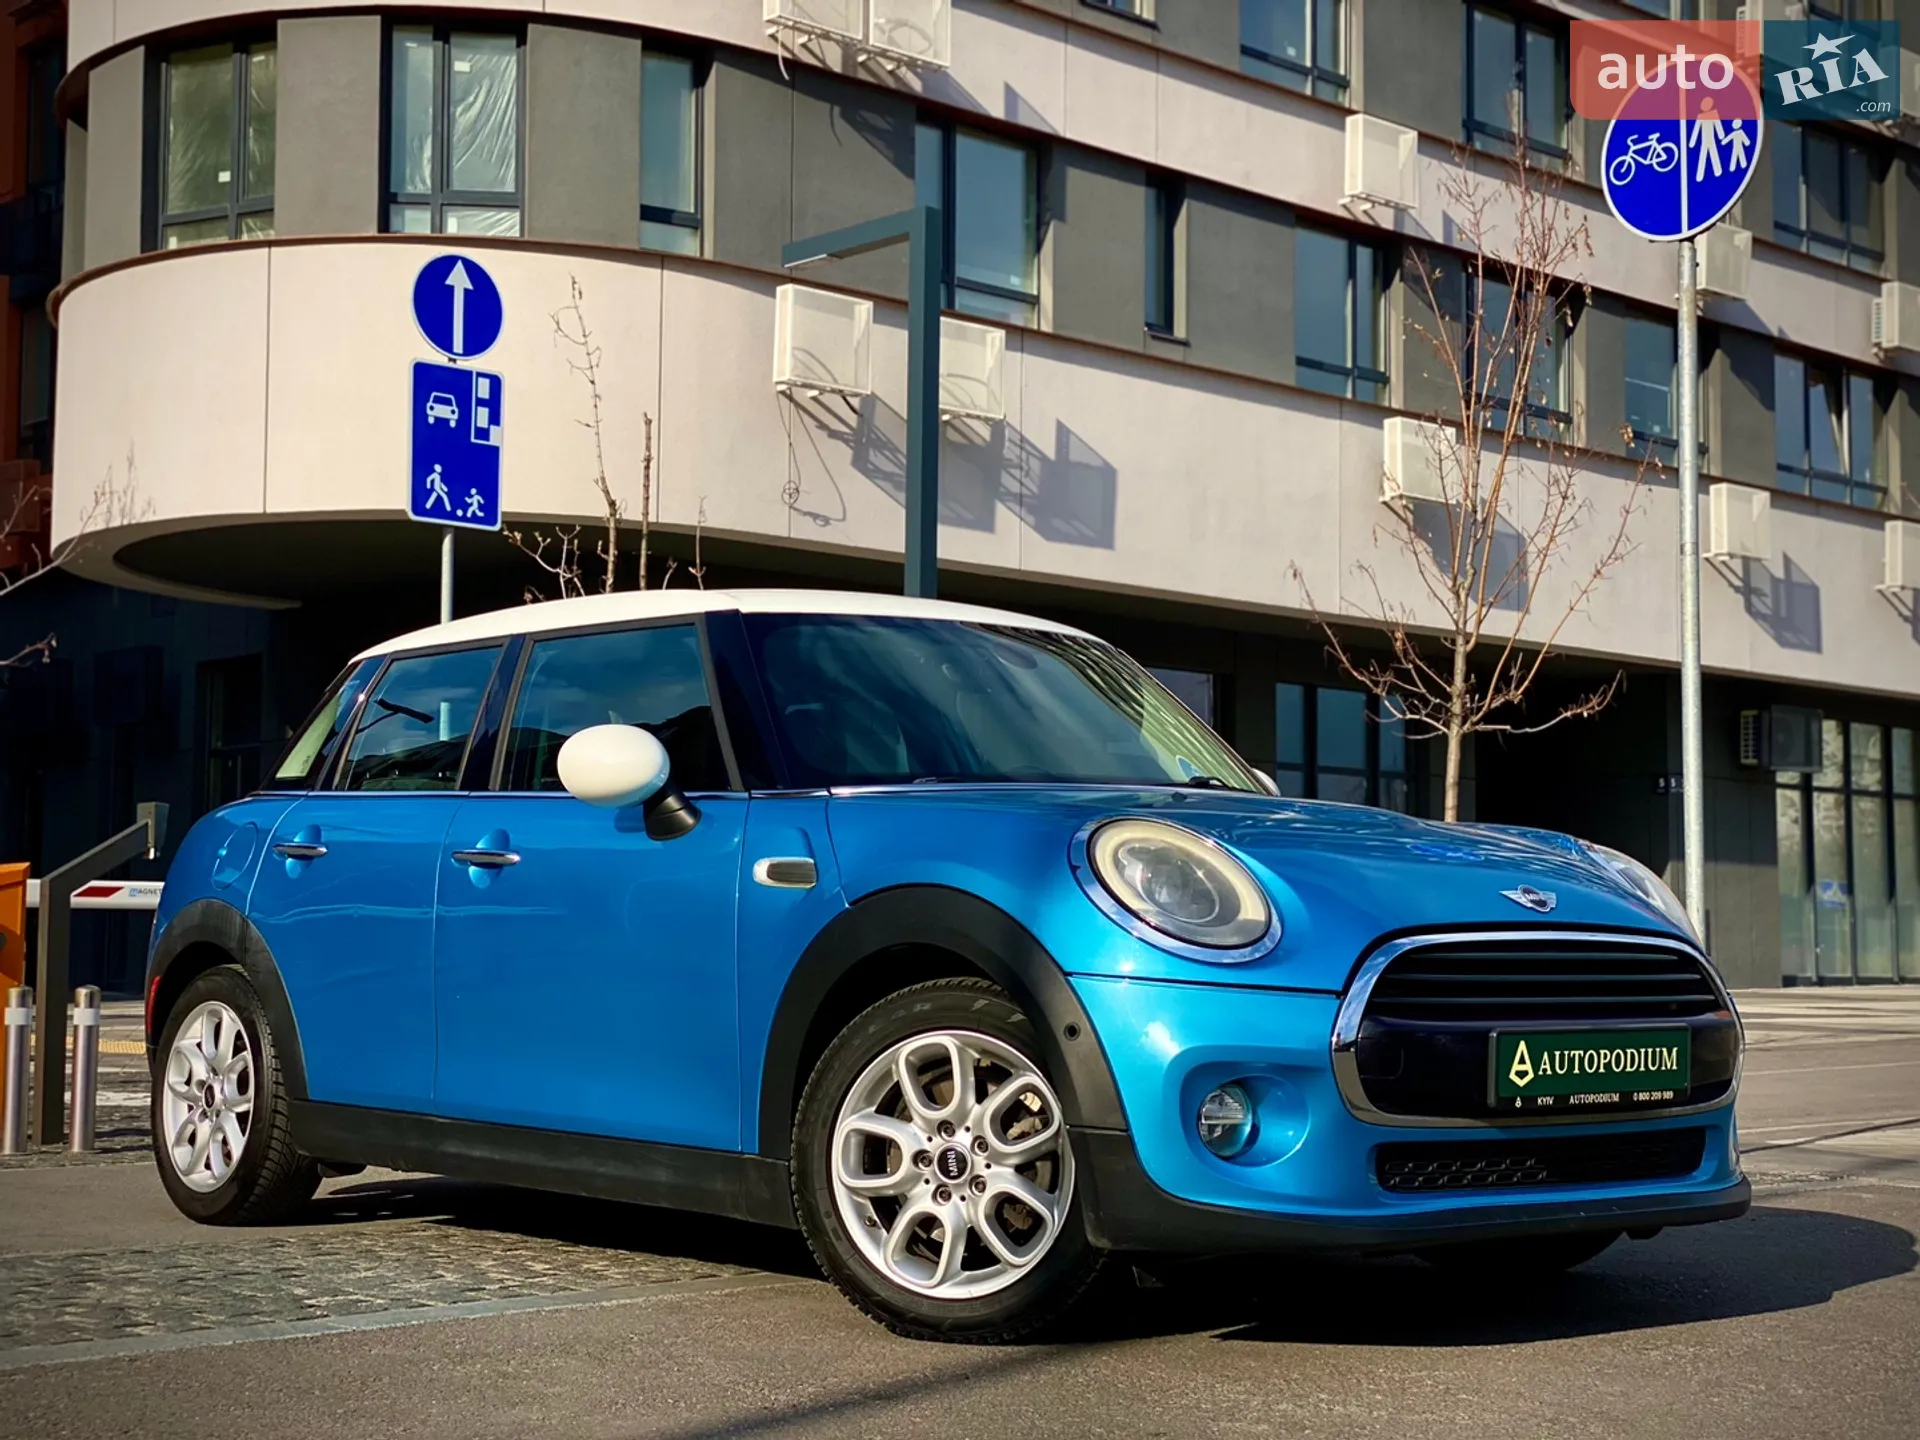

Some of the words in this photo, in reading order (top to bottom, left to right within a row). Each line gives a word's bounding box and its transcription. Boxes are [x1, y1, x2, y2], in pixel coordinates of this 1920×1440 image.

[1538, 1047, 1679, 1076] AUTOPODIUM
[1569, 1093, 1620, 1104] AUTOPODIUM
[946, 1150, 959, 1177] MINI
